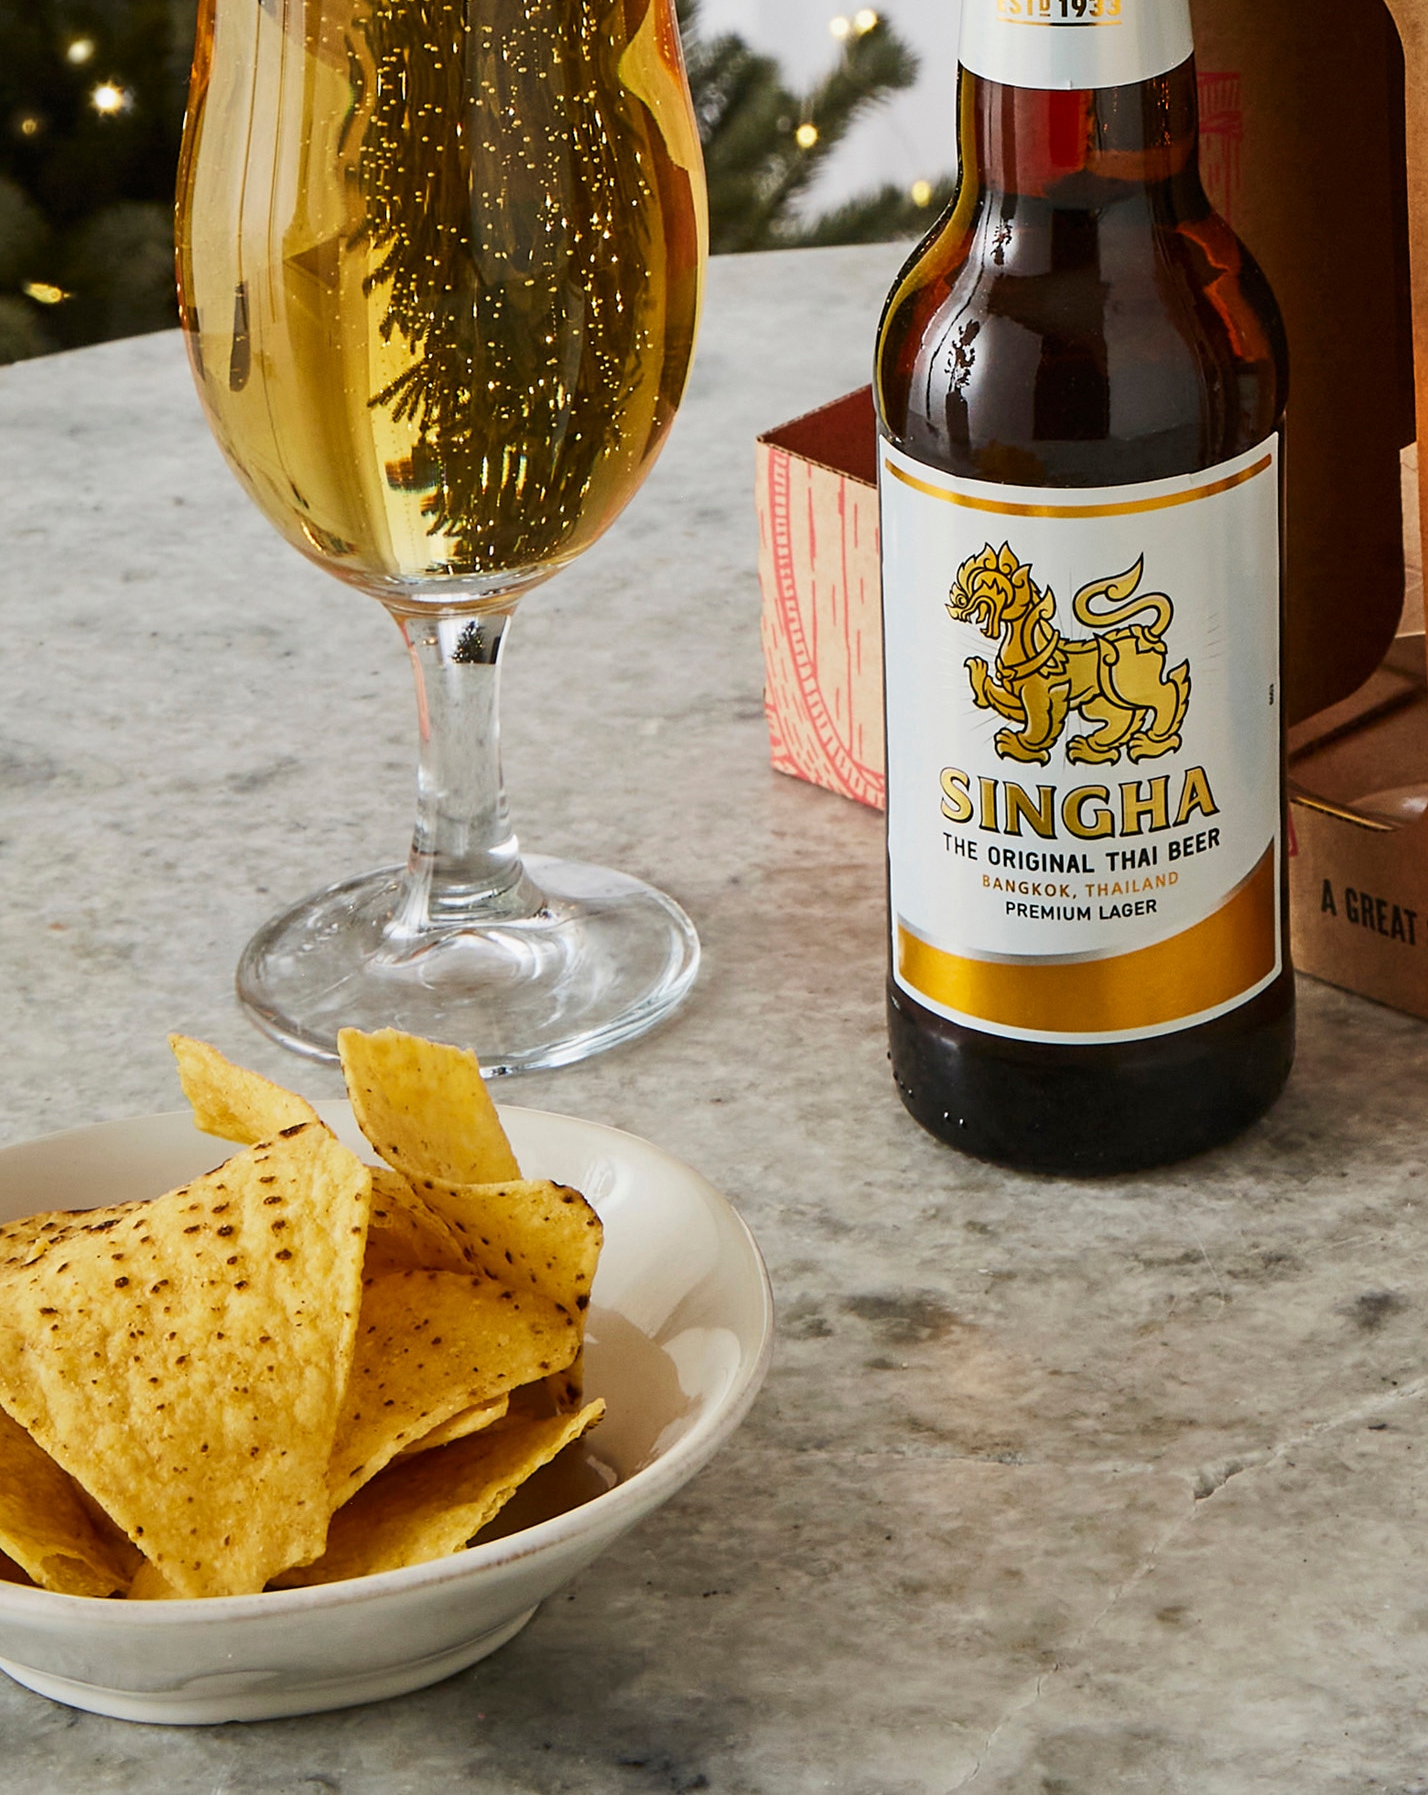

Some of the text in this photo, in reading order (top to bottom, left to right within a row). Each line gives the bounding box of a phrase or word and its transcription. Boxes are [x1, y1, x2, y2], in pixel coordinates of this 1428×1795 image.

[939, 765, 1221, 841] SINGHA
[943, 827, 1221, 874] THE ORIGINAL THAI BEER
[982, 870, 1180, 900] BANGKOK, THAILAND
[1005, 898, 1157, 921] PREMIUM LAGER
[1321, 879, 1337, 917] A
[1344, 887, 1418, 946] GREAT
